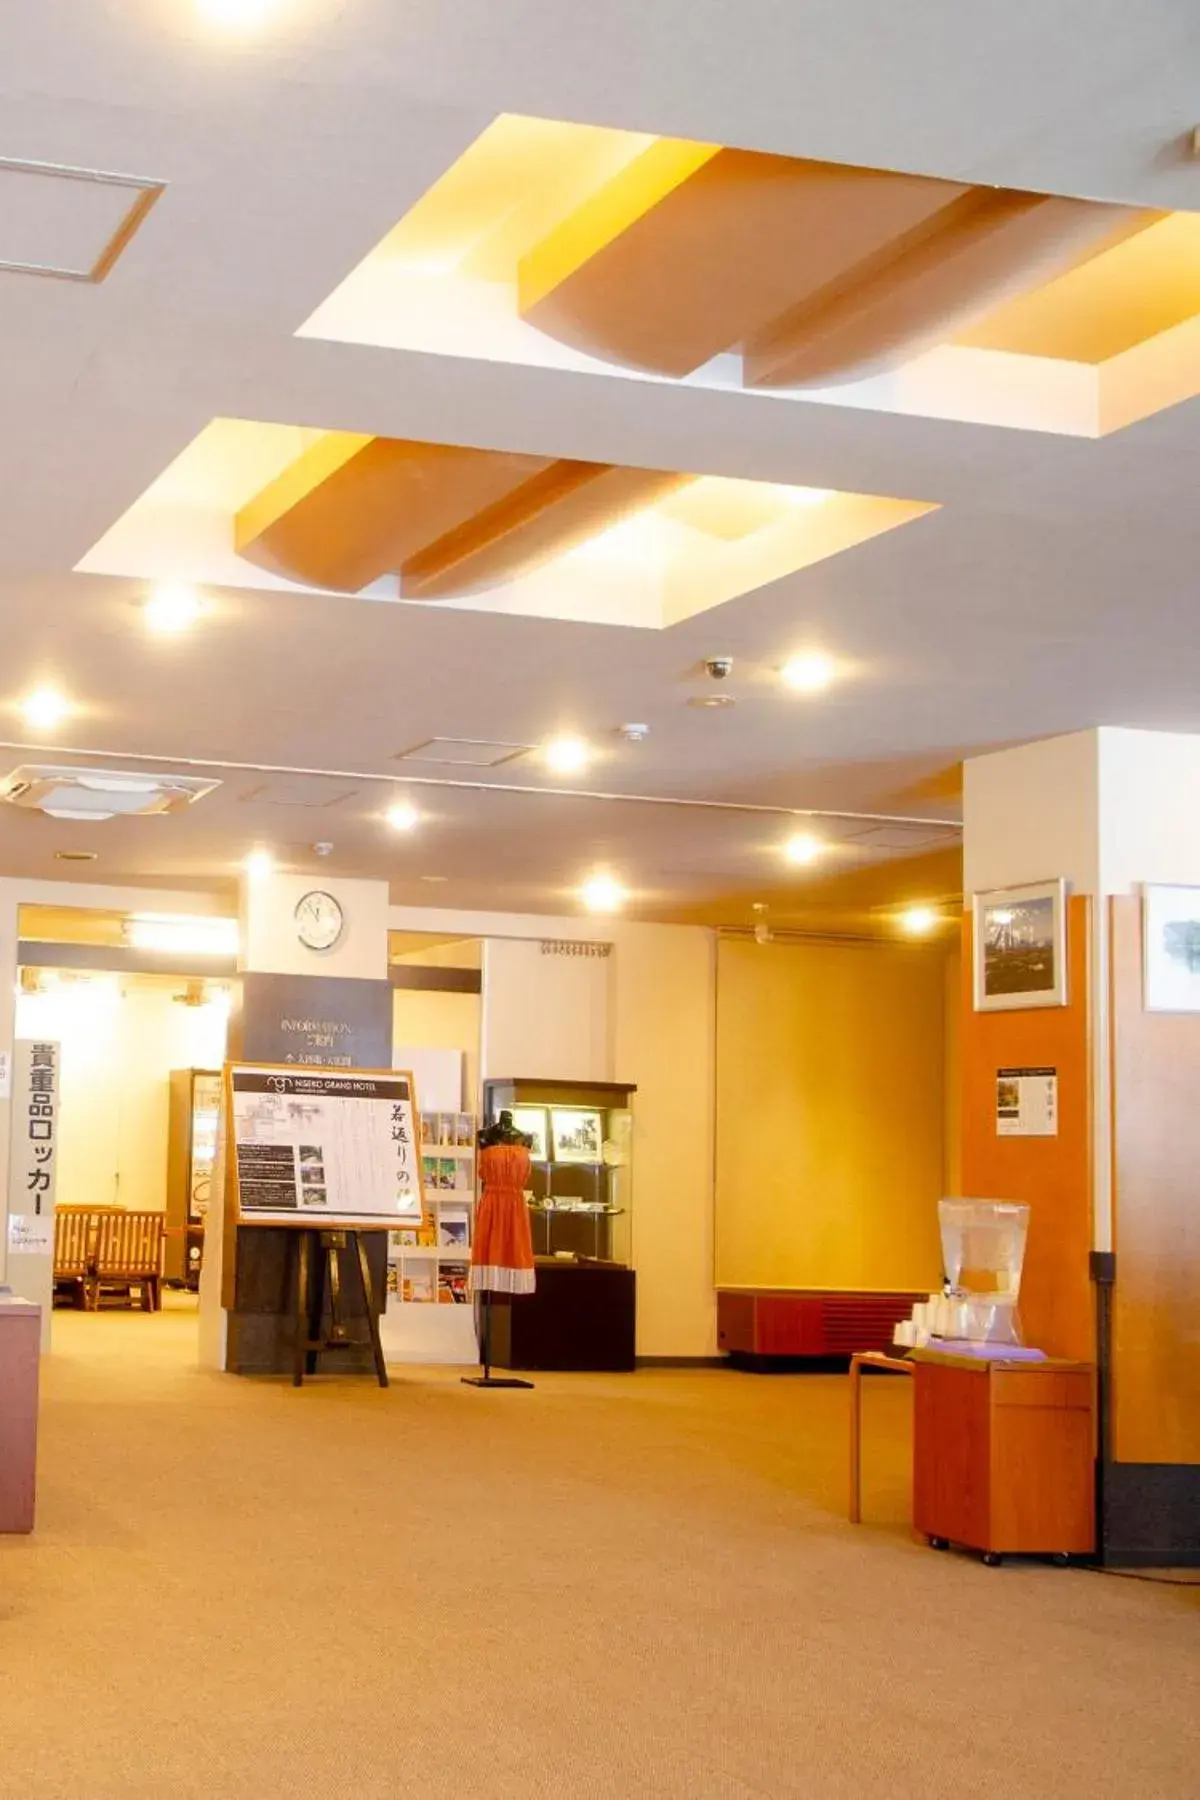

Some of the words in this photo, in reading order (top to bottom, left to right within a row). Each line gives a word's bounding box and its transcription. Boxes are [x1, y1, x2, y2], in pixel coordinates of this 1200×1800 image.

[27, 1043, 56, 1216] 貴重品ロッカー
[389, 1103, 413, 1207] 若返りの
